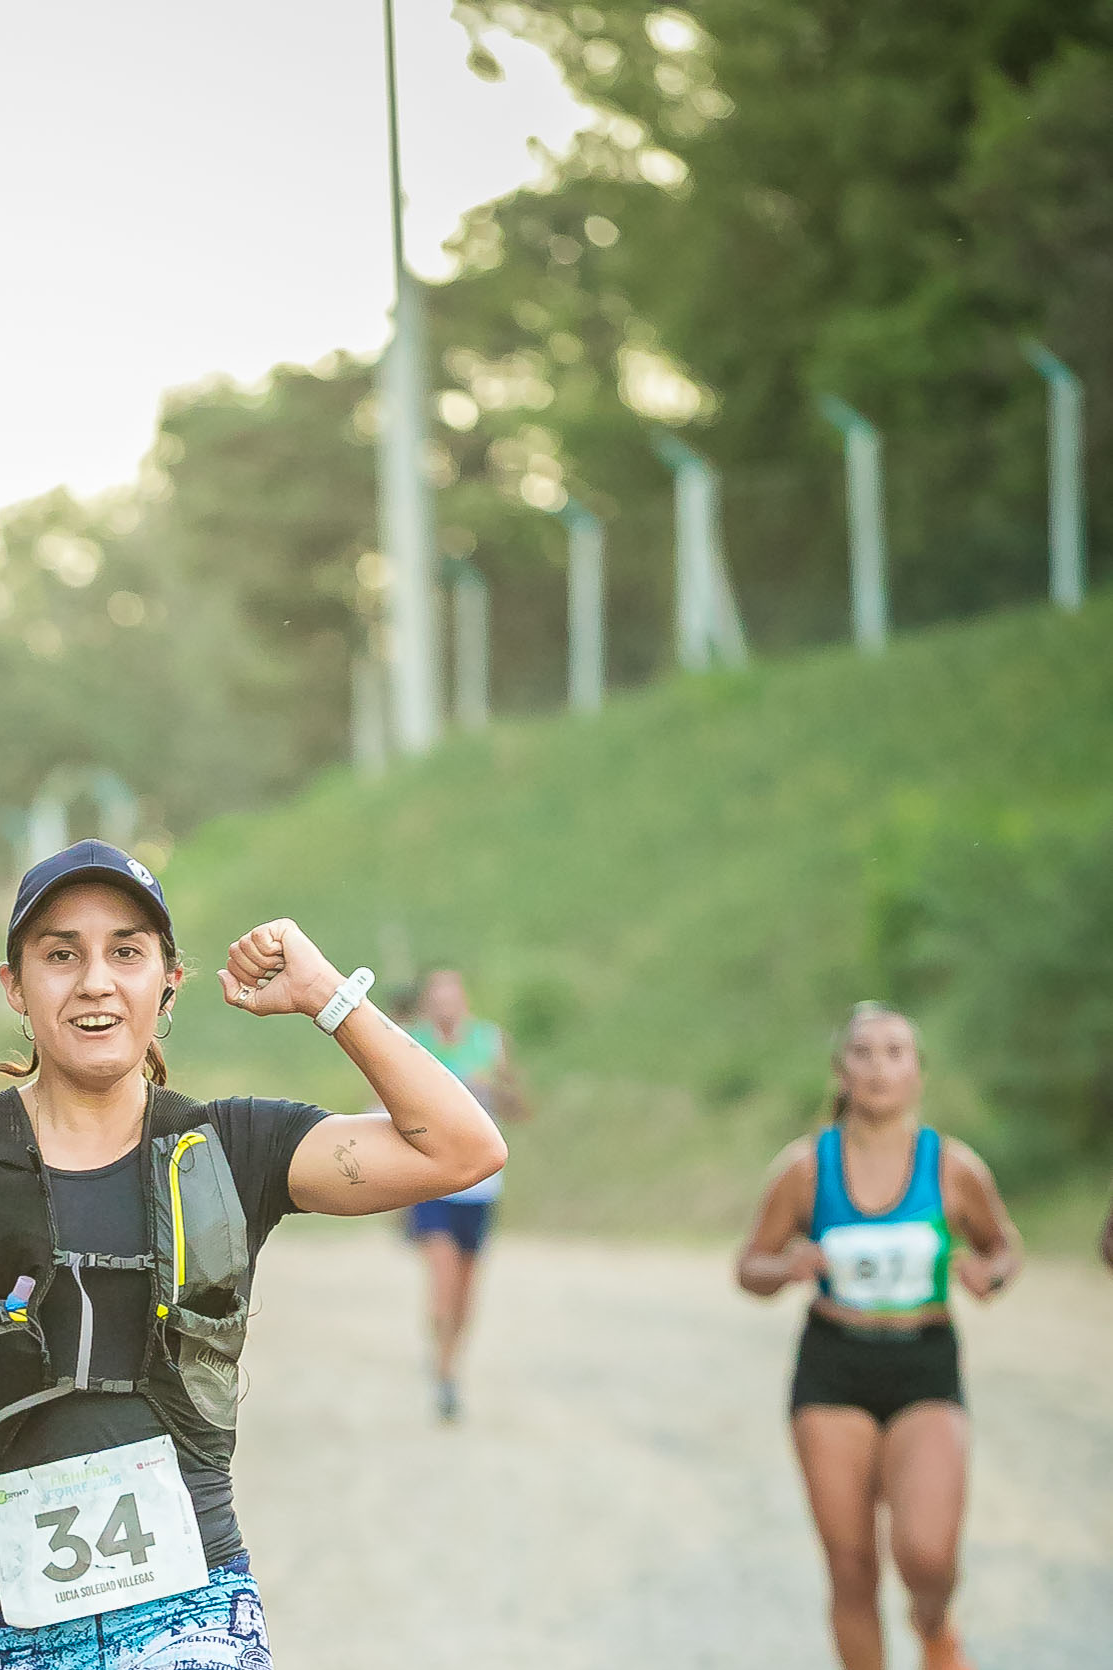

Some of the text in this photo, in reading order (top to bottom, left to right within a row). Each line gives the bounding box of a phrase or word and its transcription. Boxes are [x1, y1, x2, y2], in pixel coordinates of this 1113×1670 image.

[34, 1492, 156, 1583] 34
[55, 1571, 155, 1604] LUCIA SOLEDAD VILLEGAS
